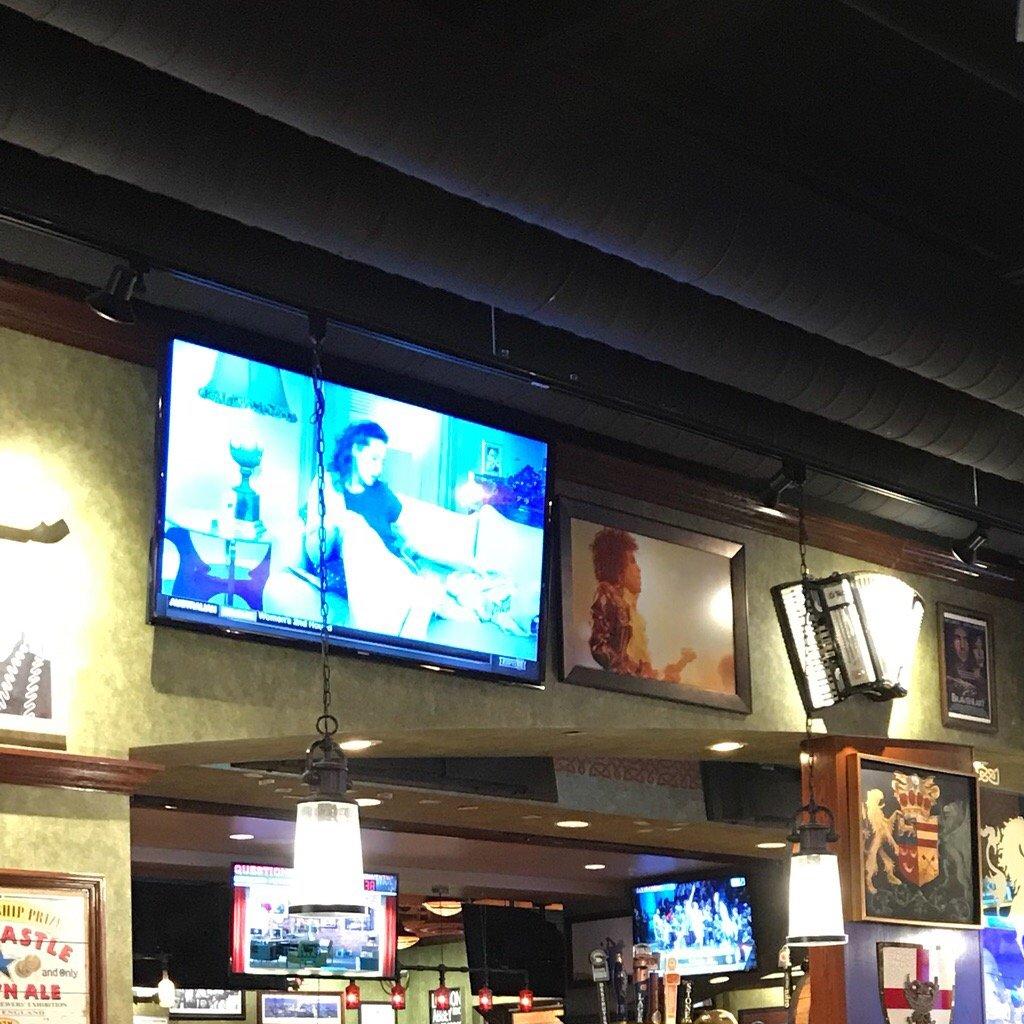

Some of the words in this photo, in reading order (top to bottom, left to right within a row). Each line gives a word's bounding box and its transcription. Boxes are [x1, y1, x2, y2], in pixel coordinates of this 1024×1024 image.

[0, 904, 24, 918] HIP
[42, 968, 58, 977] and
[24, 983, 61, 1000] ALE
